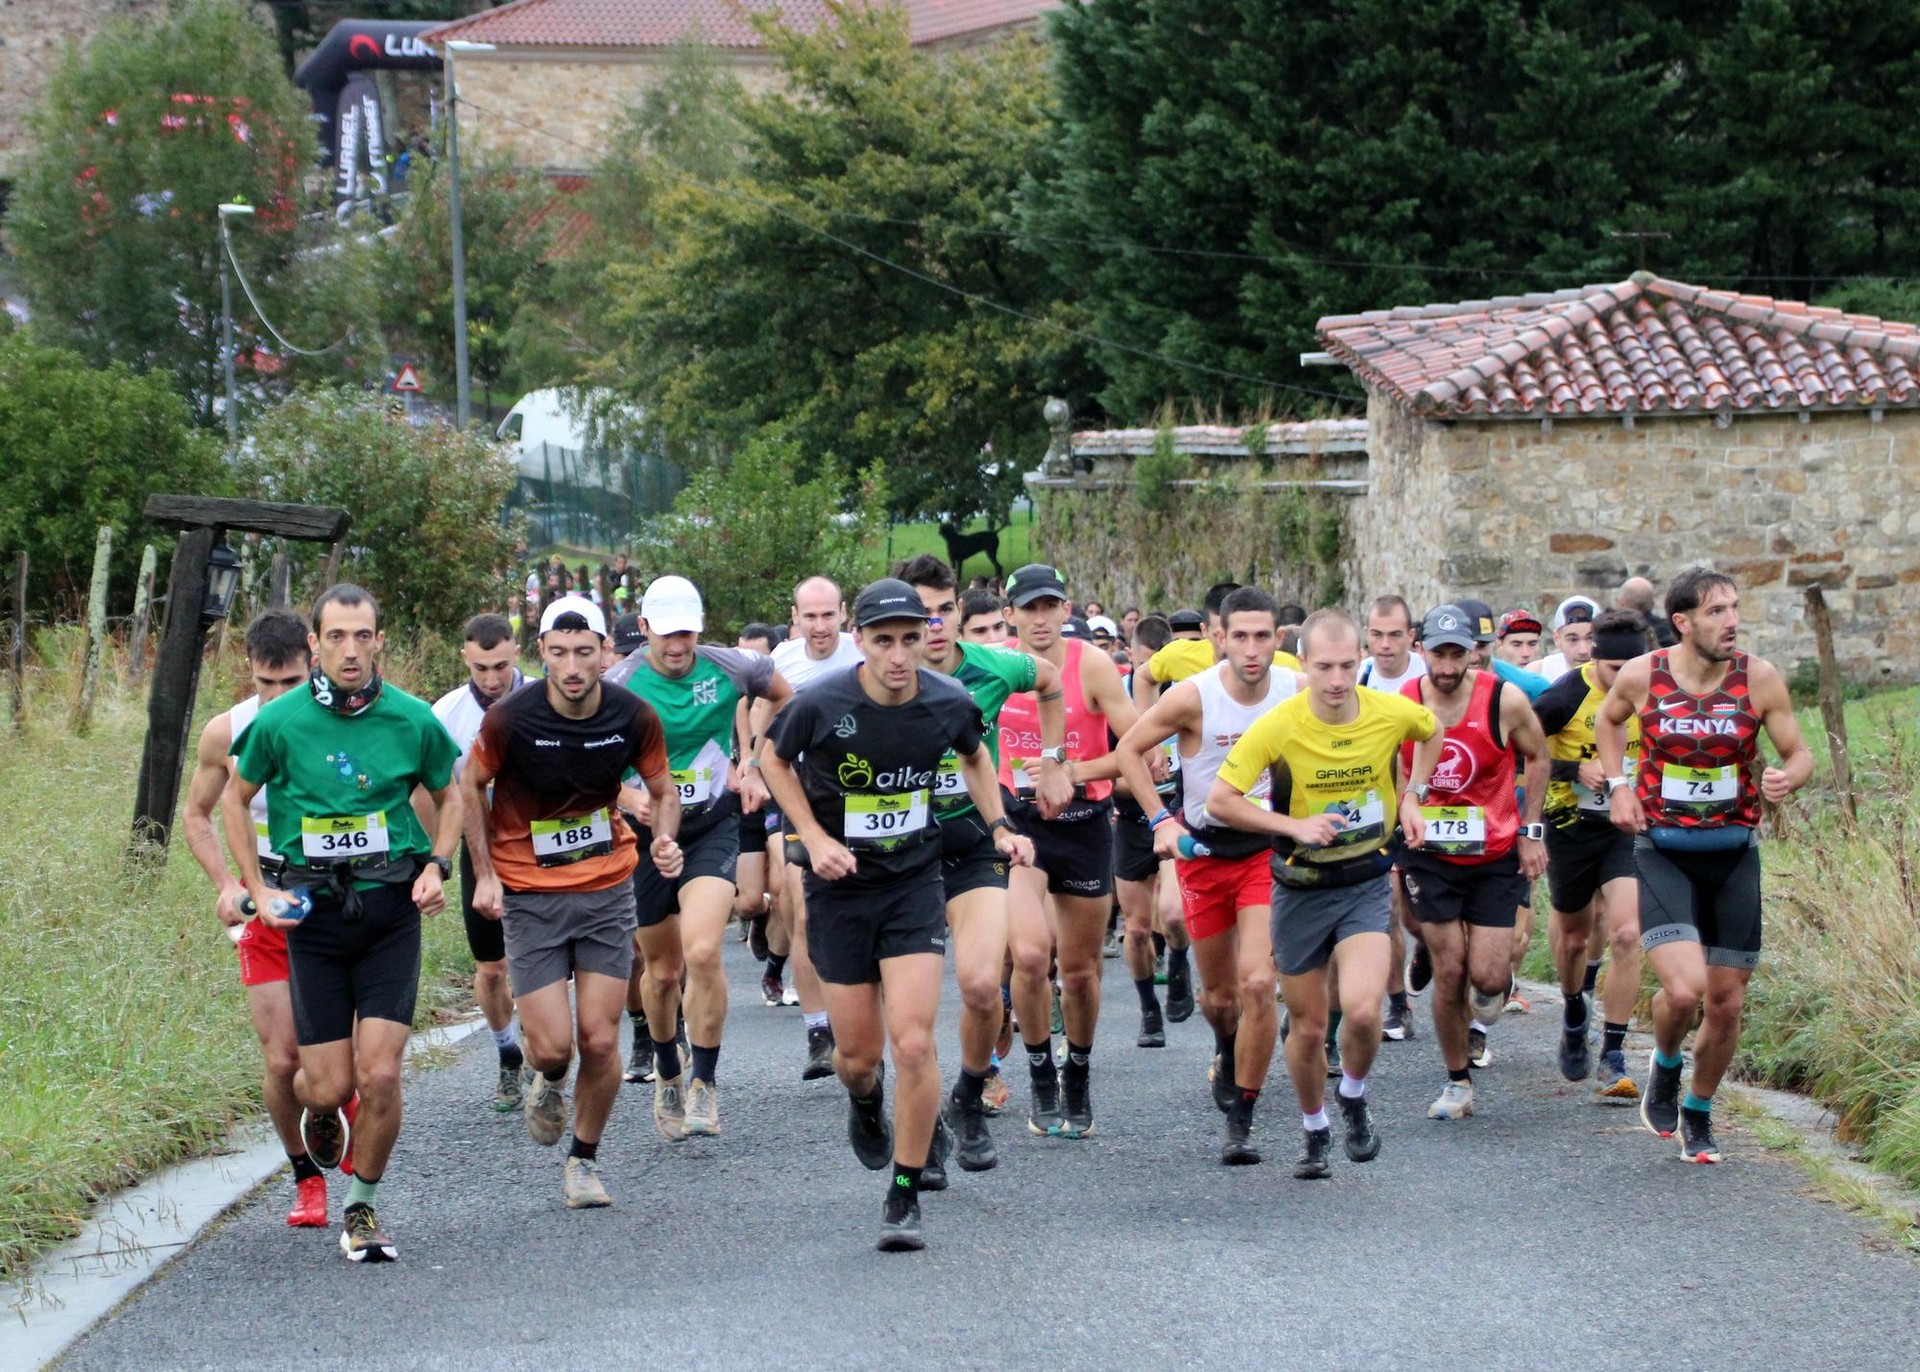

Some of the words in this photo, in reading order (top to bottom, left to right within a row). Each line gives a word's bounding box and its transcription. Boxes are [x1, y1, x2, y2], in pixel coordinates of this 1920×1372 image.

[336, 105, 361, 195] LURBEL
[313, 675, 333, 706] 20
[693, 677, 716, 692] EM
[1659, 718, 1738, 734] KENYA
[1686, 782, 1713, 795] 74
[865, 810, 910, 830] 307
[1431, 821, 1468, 834] 178
[321, 832, 368, 850] 346
[551, 826, 593, 846] 188
